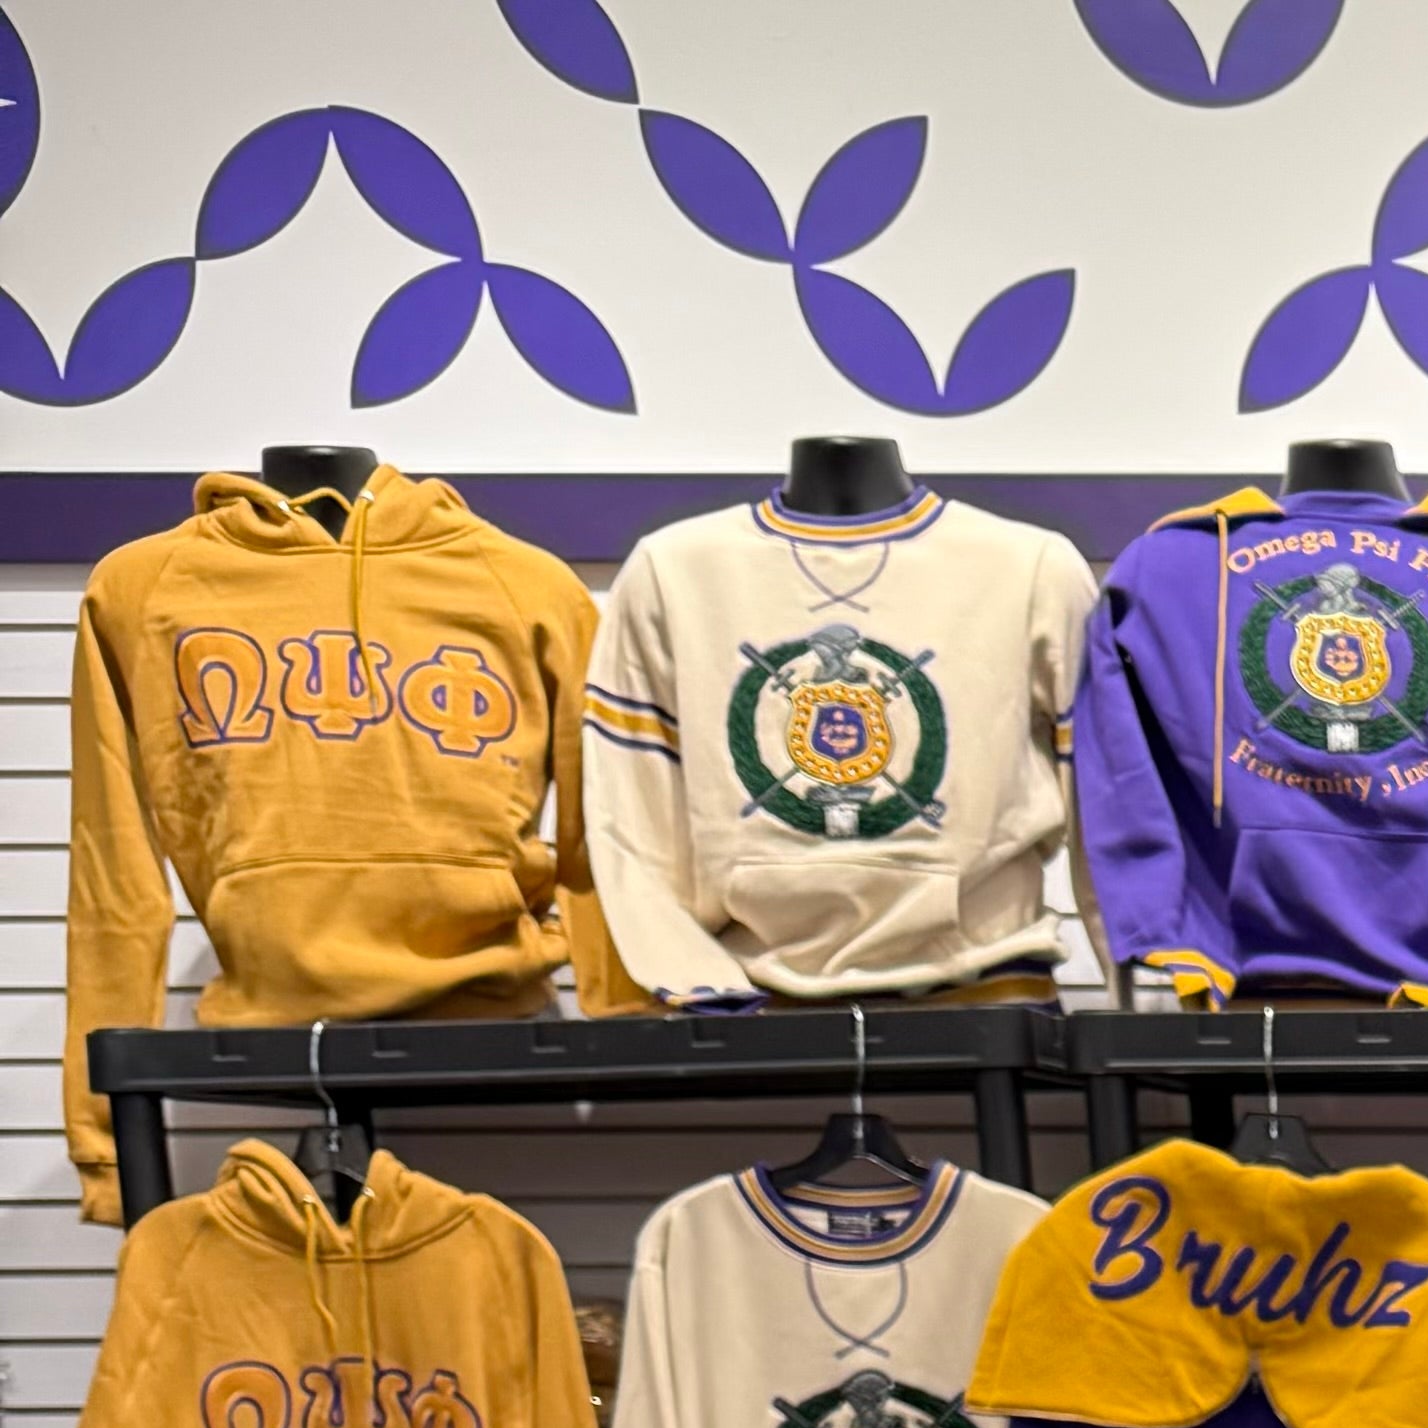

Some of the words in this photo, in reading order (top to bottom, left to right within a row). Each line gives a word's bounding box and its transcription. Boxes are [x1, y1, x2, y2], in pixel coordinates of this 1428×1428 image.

[1226, 529, 1337, 574] Omega
[1350, 530, 1401, 562] Psi
[1229, 738, 1373, 801] Fraternity
